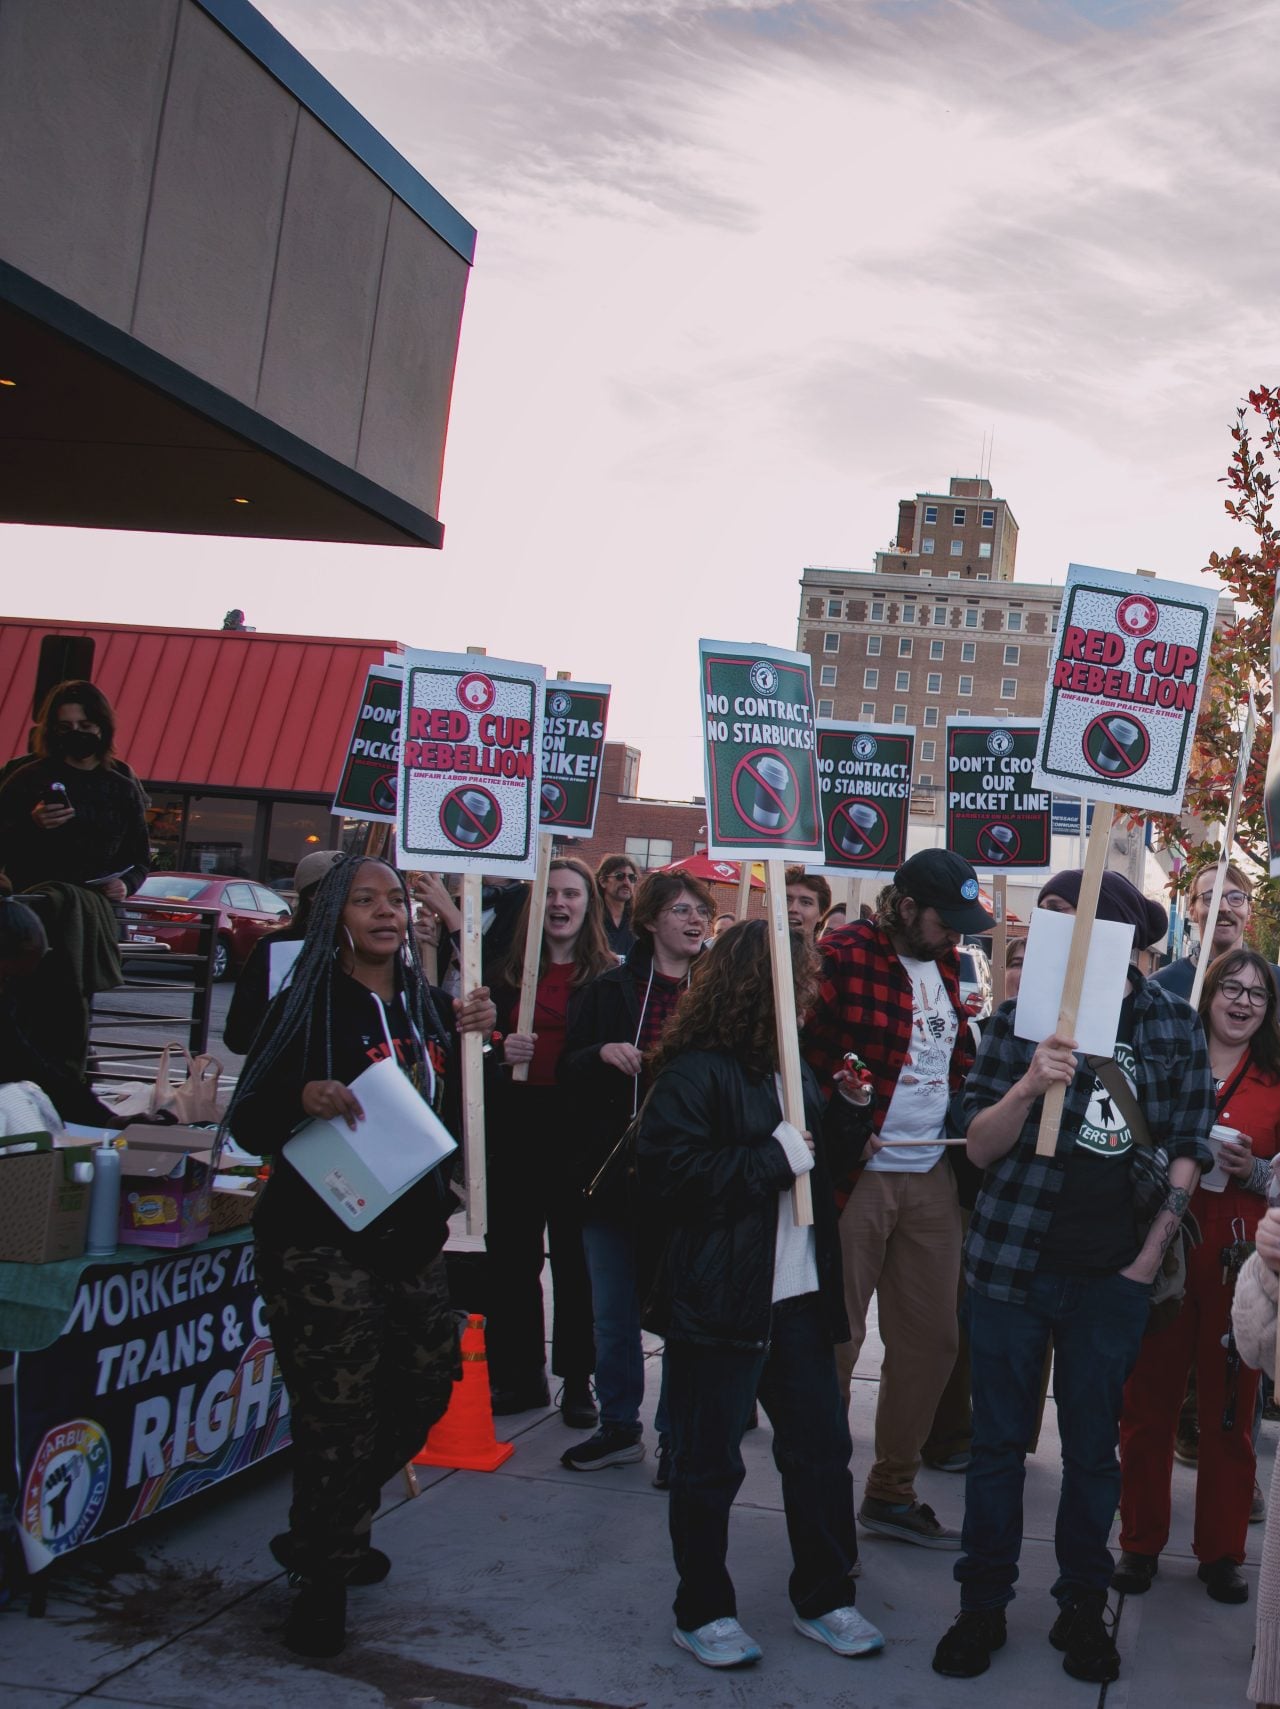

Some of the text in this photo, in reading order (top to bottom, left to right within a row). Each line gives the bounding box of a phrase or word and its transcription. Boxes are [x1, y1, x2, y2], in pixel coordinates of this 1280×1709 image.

[1063, 625, 1199, 680] RED CUP
[1053, 659, 1197, 712] REBELLION
[361, 704, 401, 725] DON'
[706, 694, 813, 728] NO CONTRACT,
[1061, 692, 1183, 720] UNFAIR LABOR PRACTICE STRIKE
[408, 706, 470, 743] RED
[478, 713, 532, 750] CUP
[543, 716, 604, 739] RISTAS
[707, 720, 815, 751] NO STARBUCKS!
[352, 738, 400, 763] PICKE
[542, 735, 567, 752] ON
[403, 740, 534, 780] REBELLION
[541, 751, 598, 778] RIKE!
[838, 760, 910, 782] CONTRACT,
[949, 756, 1037, 774] DON'T CRO
[413, 772, 526, 788] UNFAIR LABOR PRACTICE STRIKE
[834, 780, 910, 799] STARBUCKS!
[982, 774, 1015, 791] OUR
[949, 792, 1049, 811] PICKET LINE
[95, 1312, 214, 1397] TRANS
[221, 1304, 244, 1353] &
[124, 1351, 291, 1489] RIGH
[68, 1481, 105, 1546] UNITED
